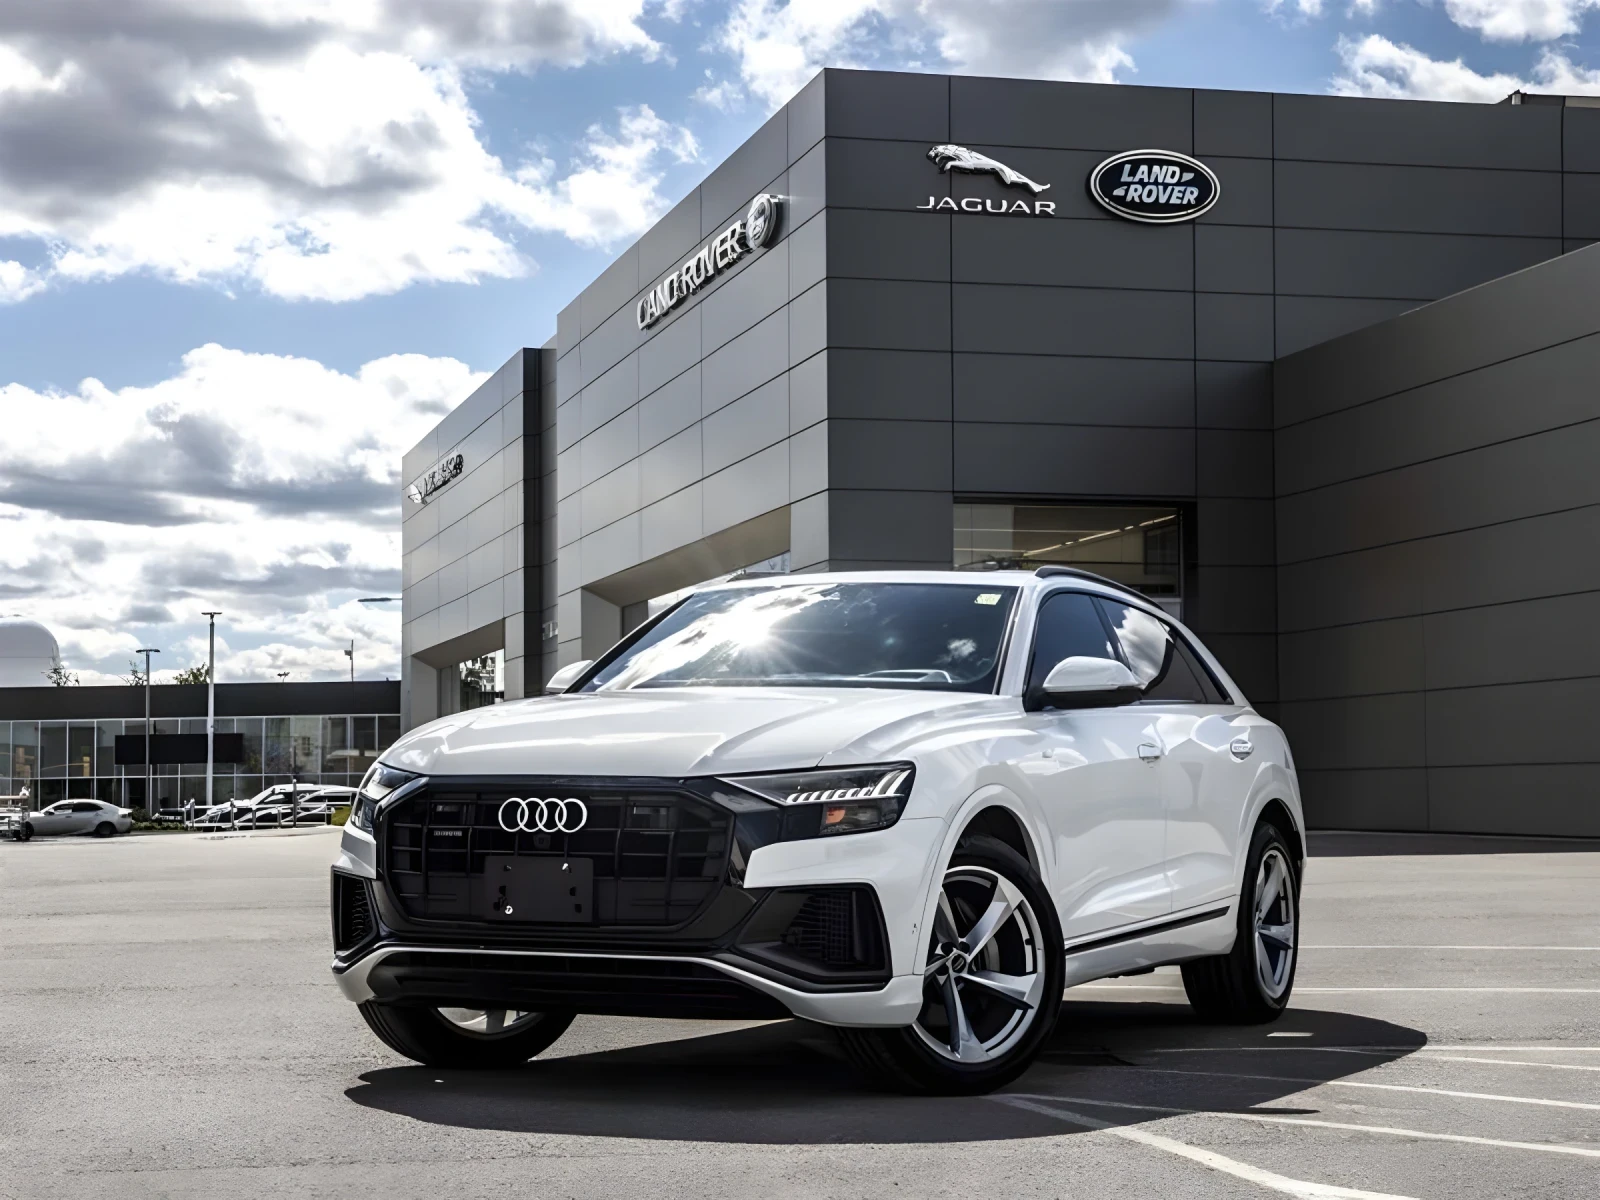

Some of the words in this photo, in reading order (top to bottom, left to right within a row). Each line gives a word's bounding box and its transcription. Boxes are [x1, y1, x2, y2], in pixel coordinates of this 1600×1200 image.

[1120, 163, 1181, 184] LAND
[1125, 184, 1199, 205] ROVER
[916, 196, 1056, 215] JAGUAR
[636, 271, 680, 331] LAND
[680, 220, 744, 295] ROVER
